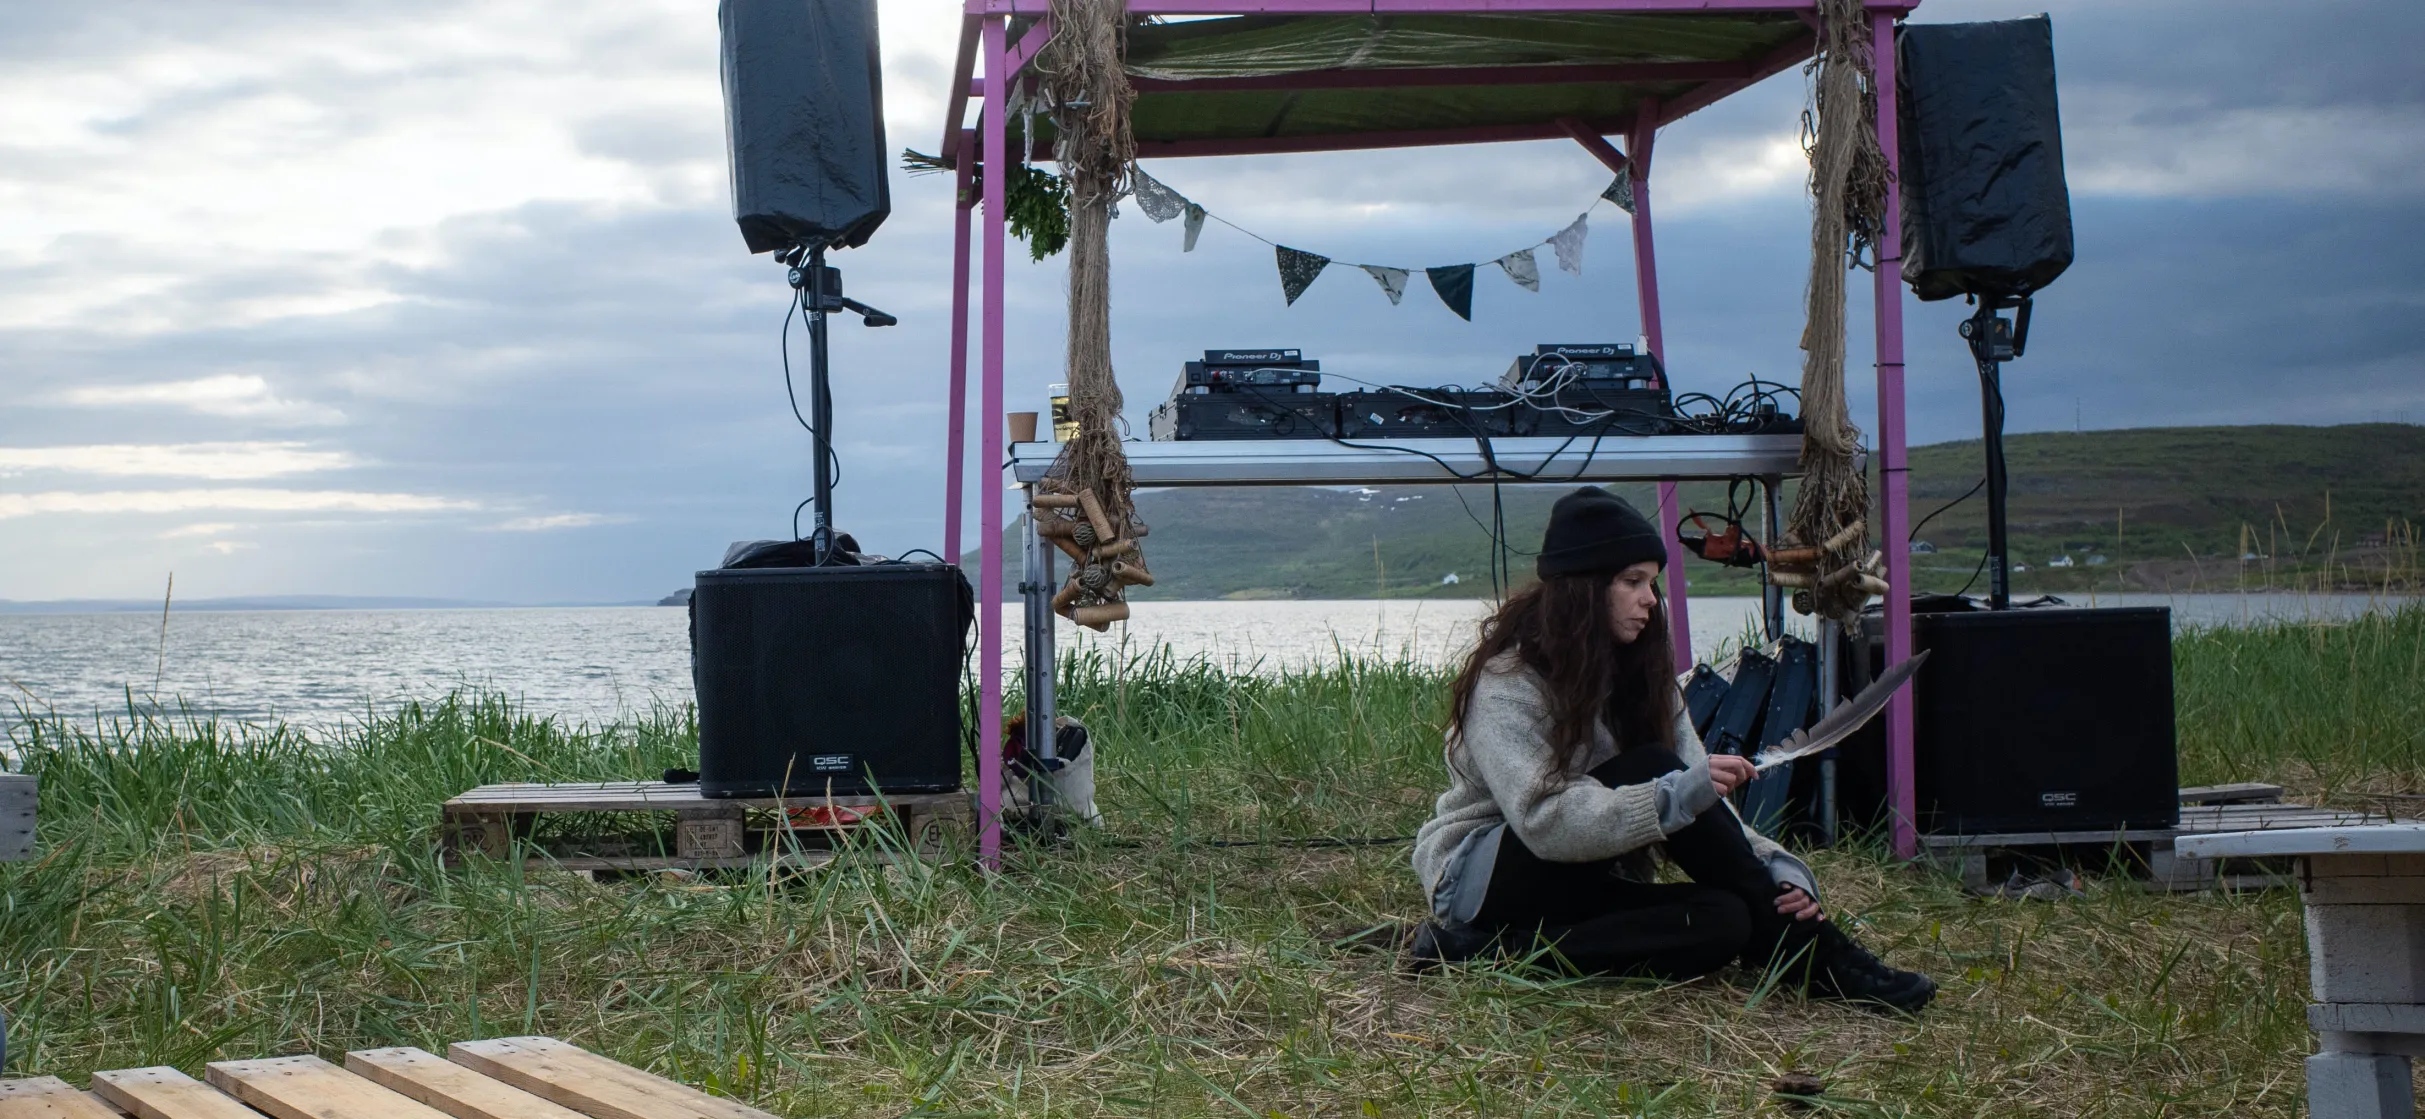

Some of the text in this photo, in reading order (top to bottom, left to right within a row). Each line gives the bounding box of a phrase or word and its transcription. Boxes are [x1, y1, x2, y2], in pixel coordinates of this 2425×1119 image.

[1224, 352, 1267, 360] Pioneer
[814, 756, 849, 765] QSC
[2042, 793, 2076, 801] QSC
